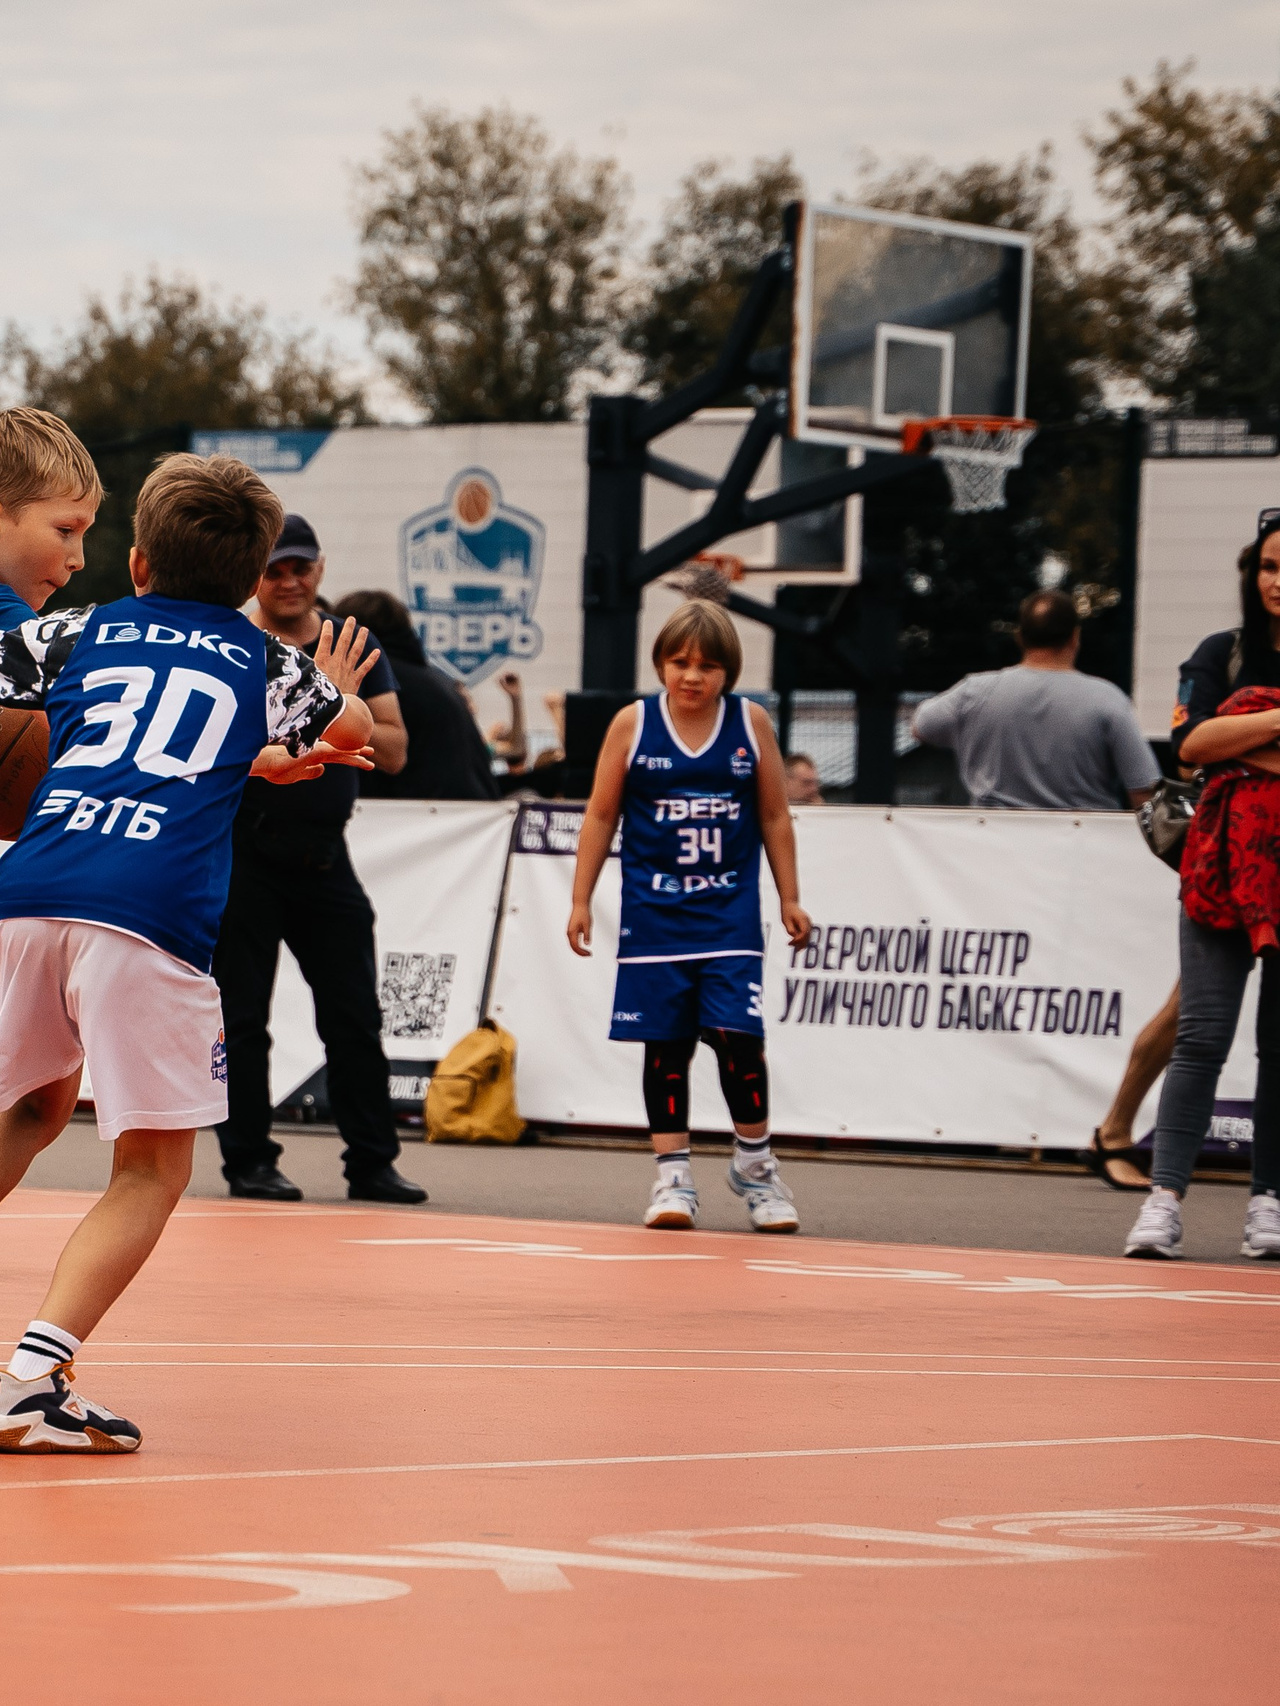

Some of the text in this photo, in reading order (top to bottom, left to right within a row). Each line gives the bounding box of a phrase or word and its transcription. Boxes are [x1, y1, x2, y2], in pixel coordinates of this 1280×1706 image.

[145, 624, 252, 669] DKC
[52, 666, 238, 784] 30
[64, 796, 168, 840] ВТБ
[677, 828, 722, 865] 34
[939, 926, 1030, 977] ЦЕНТР
[779, 977, 1124, 1037] УЛИЧНОГО БАСКЕТБОЛА
